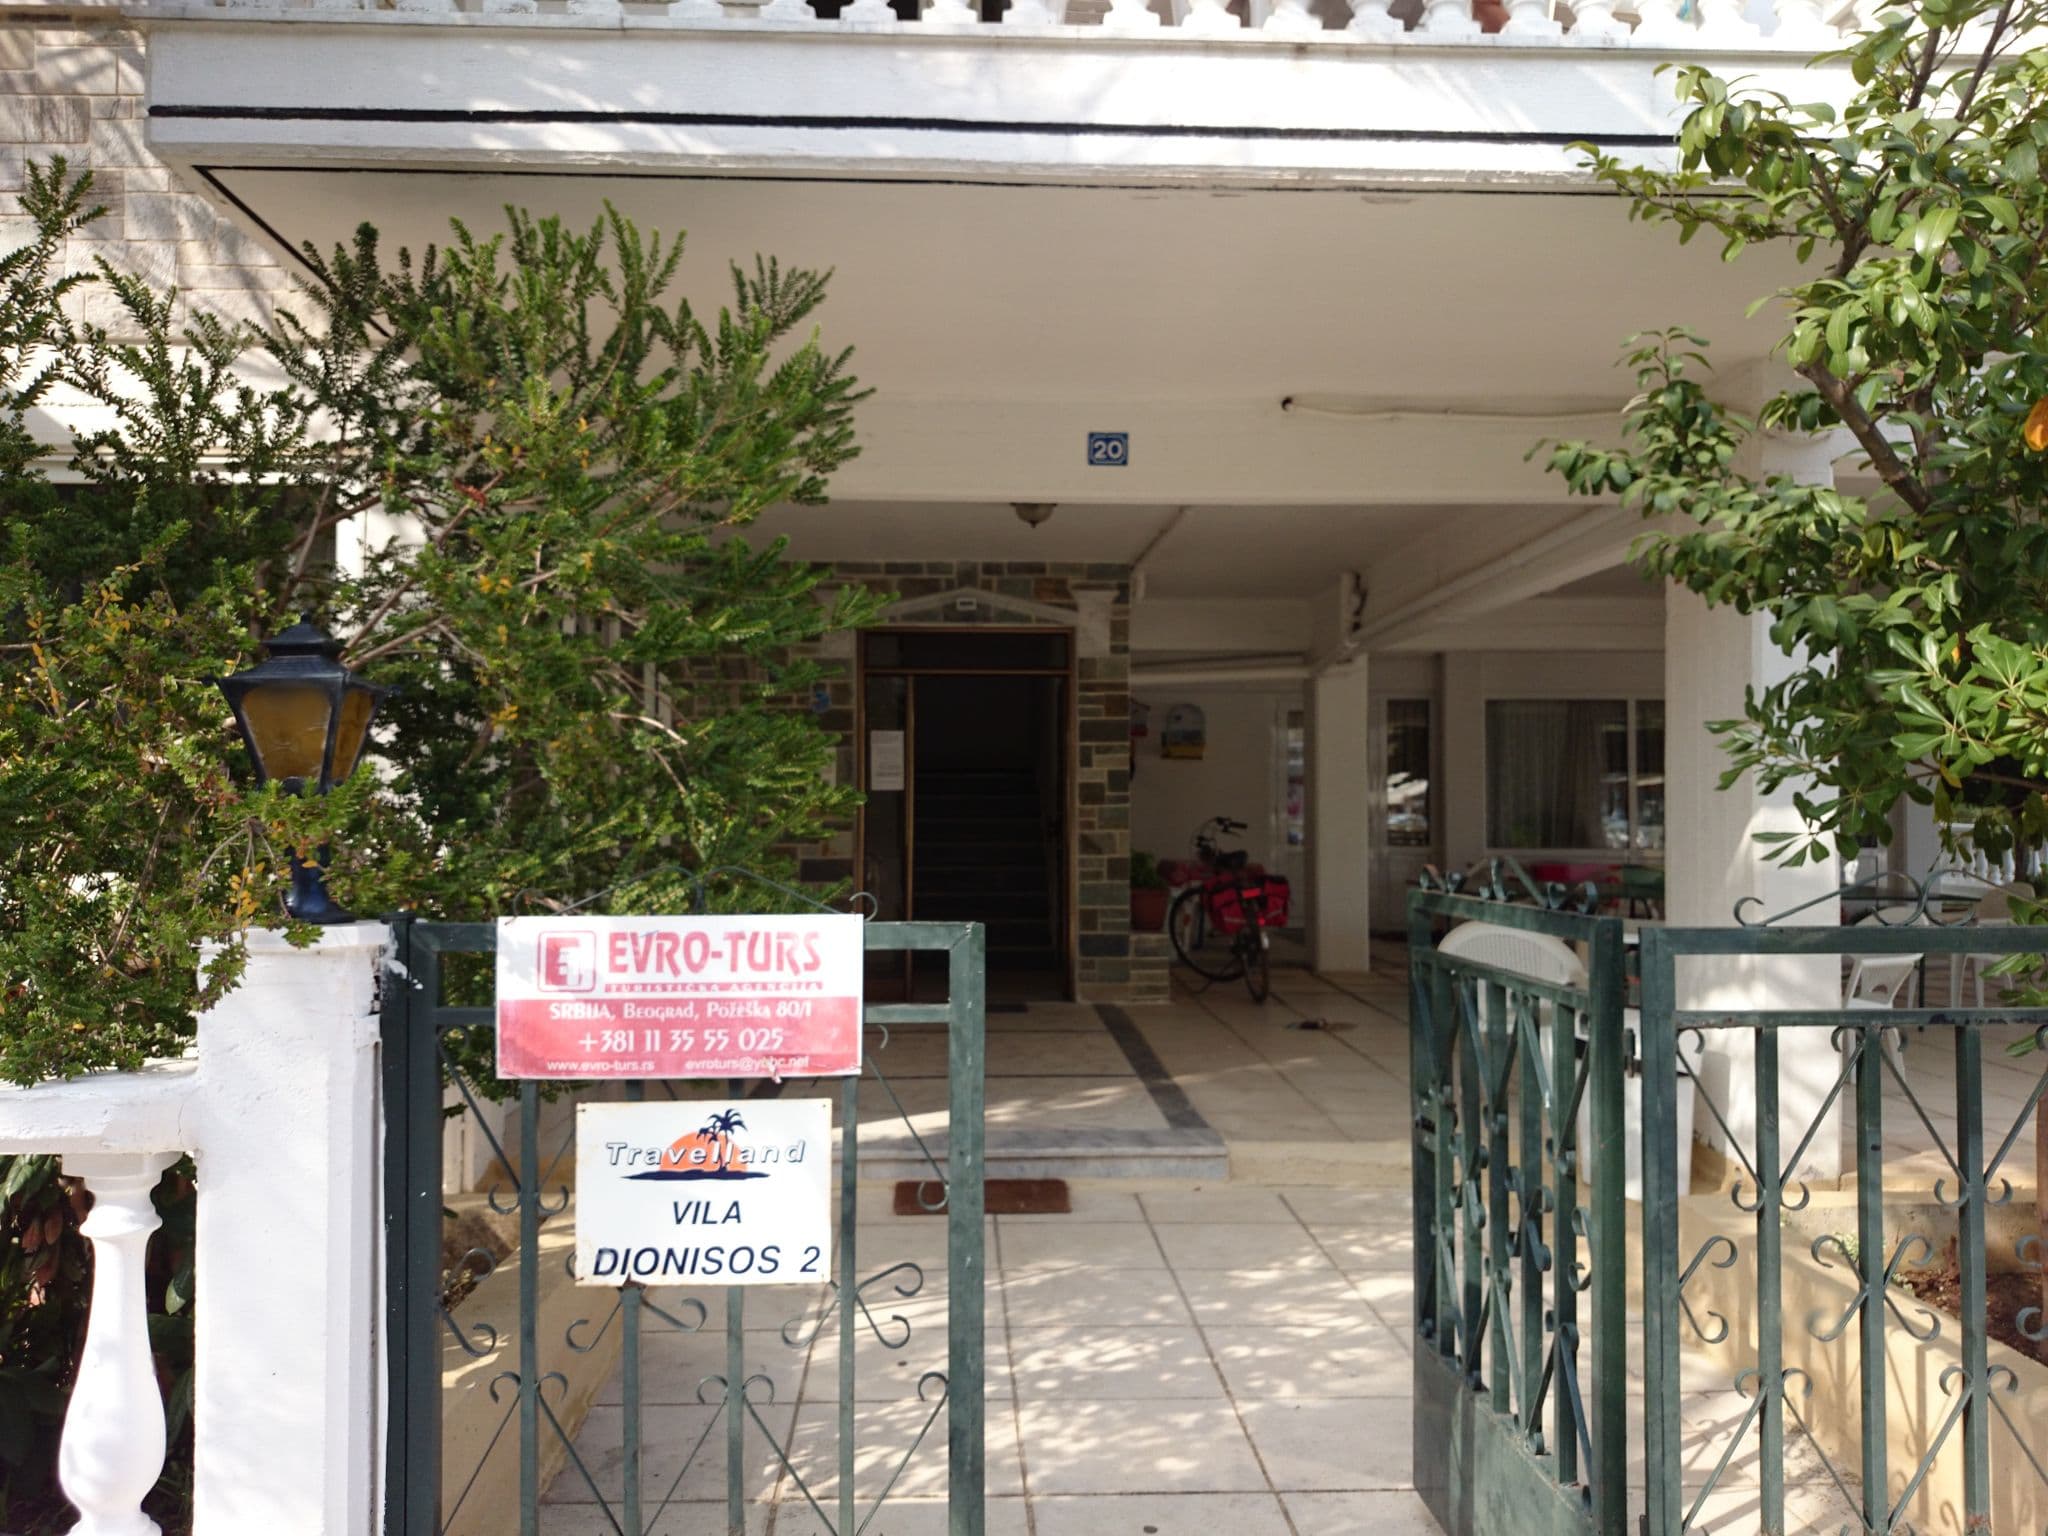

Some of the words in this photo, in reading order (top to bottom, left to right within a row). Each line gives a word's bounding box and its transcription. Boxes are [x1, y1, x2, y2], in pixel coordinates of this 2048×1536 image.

[1093, 440, 1123, 459] 20
[608, 930, 822, 977] EVRO-TURS
[578, 1028, 635, 1053] +381
[644, 1029, 661, 1052] 11
[669, 1028, 695, 1052] 35
[703, 1027, 730, 1052] 55
[738, 1026, 784, 1051] 025
[547, 1059, 655, 1072] www.evro-turs.rs
[606, 1139, 806, 1166] Travelland
[672, 1200, 742, 1225] VILA
[592, 1245, 782, 1276] DIONISOS
[799, 1245, 821, 1274] 2
